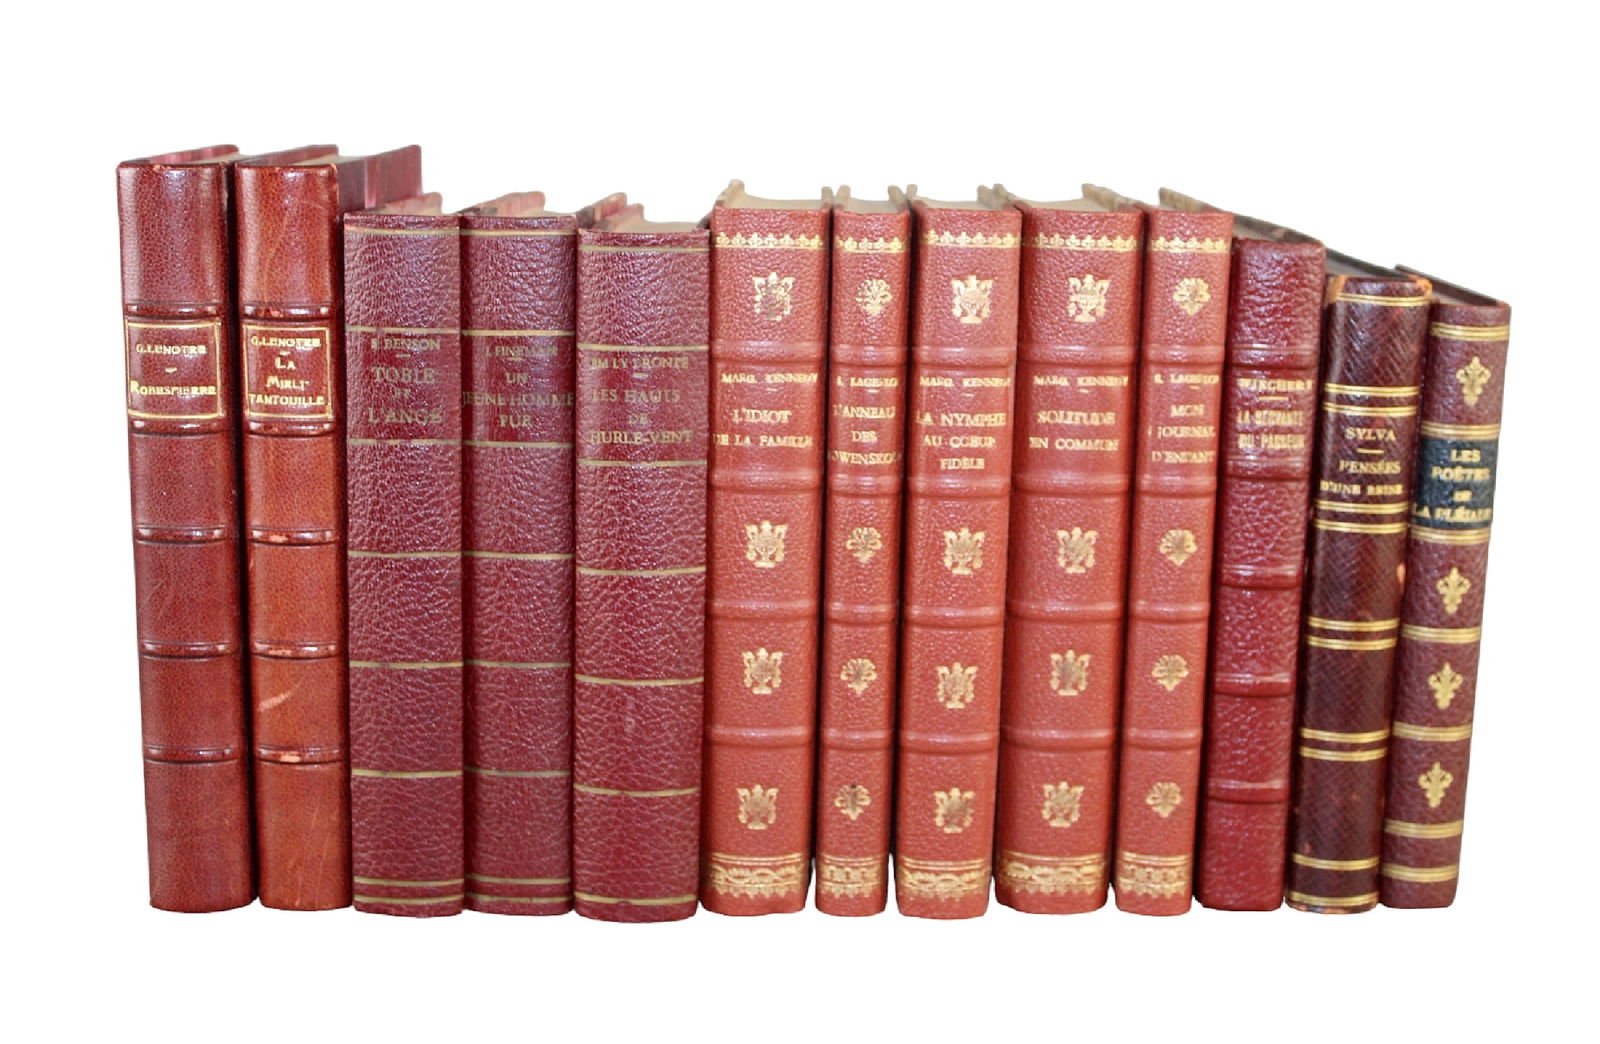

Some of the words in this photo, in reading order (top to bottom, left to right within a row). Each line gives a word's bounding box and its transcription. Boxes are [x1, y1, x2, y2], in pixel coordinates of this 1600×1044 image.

[384, 339, 440, 350] BENSON
[274, 357, 296, 369] LA
[590, 357, 629, 369] EMLY
[372, 367, 435, 383] TOBIE
[505, 372, 529, 383] UN
[509, 394, 574, 406] HOMME
[592, 389, 618, 401] LES
[624, 389, 681, 403] HAUTS
[368, 408, 442, 424] L'ANGE
[732, 408, 792, 423] L'IDIOT
[1170, 404, 1205, 417] MON
[1237, 410, 1250, 424] LA
[500, 415, 533, 427] PUR
[628, 414, 648, 424] DE
[915, 411, 933, 424] LA
[940, 412, 1007, 427] NYMPHE
[1037, 410, 1116, 425] SOLITUDE
[735, 434, 751, 446] LA
[852, 430, 877, 442] DES
[1345, 427, 1396, 441] SYLVA
[923, 435, 942, 447] AU
[1029, 437, 1048, 449] EN
[1055, 438, 1119, 451] COMMUN
[1450, 449, 1481, 462] LES
